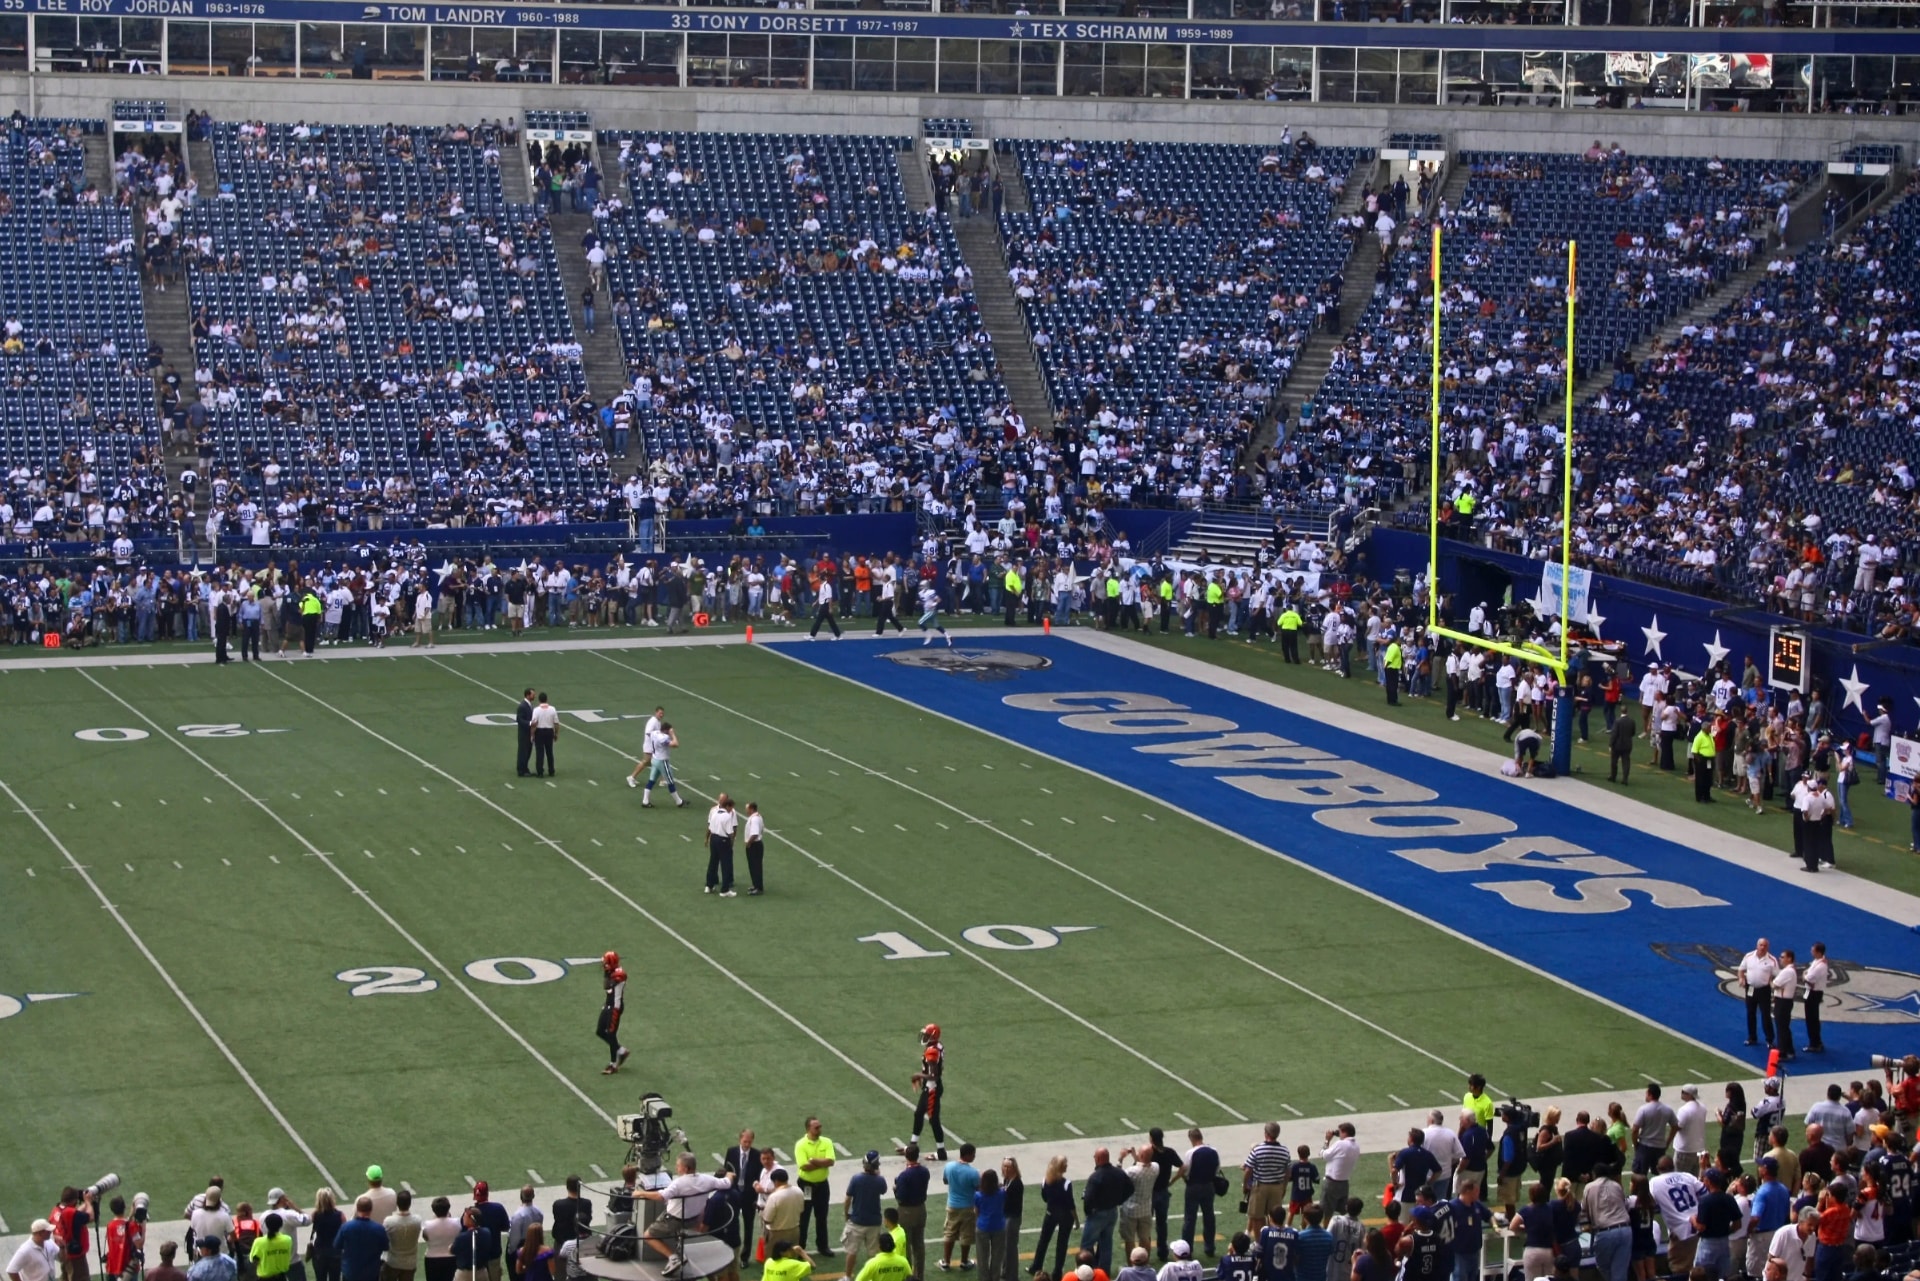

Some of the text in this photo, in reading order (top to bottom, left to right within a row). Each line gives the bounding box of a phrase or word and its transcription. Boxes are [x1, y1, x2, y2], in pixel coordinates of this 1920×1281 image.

[4, 0, 265, 15] 55 LEE ROY JORDAN 1963-1976
[388, 7, 579, 23] TOM LANDRY 1960-1988
[671, 15, 919, 31] 33 TONY DORSETT 1977-1987
[1031, 23, 1233, 40] TEX SCHRAMM 1959-1989
[1775, 637, 1800, 671] 25
[1002, 691, 1732, 914] COWBOYS
[856, 924, 1061, 960] 10
[335, 965, 567, 997] 20
[1298, 1176, 1311, 1190] 81
[1891, 1173, 1911, 1198] 24
[1668, 1184, 1696, 1213] 81
[1440, 1216, 1454, 1244] 41
[1272, 1242, 1288, 1270] 8
[1421, 1254, 1433, 1275] 3
